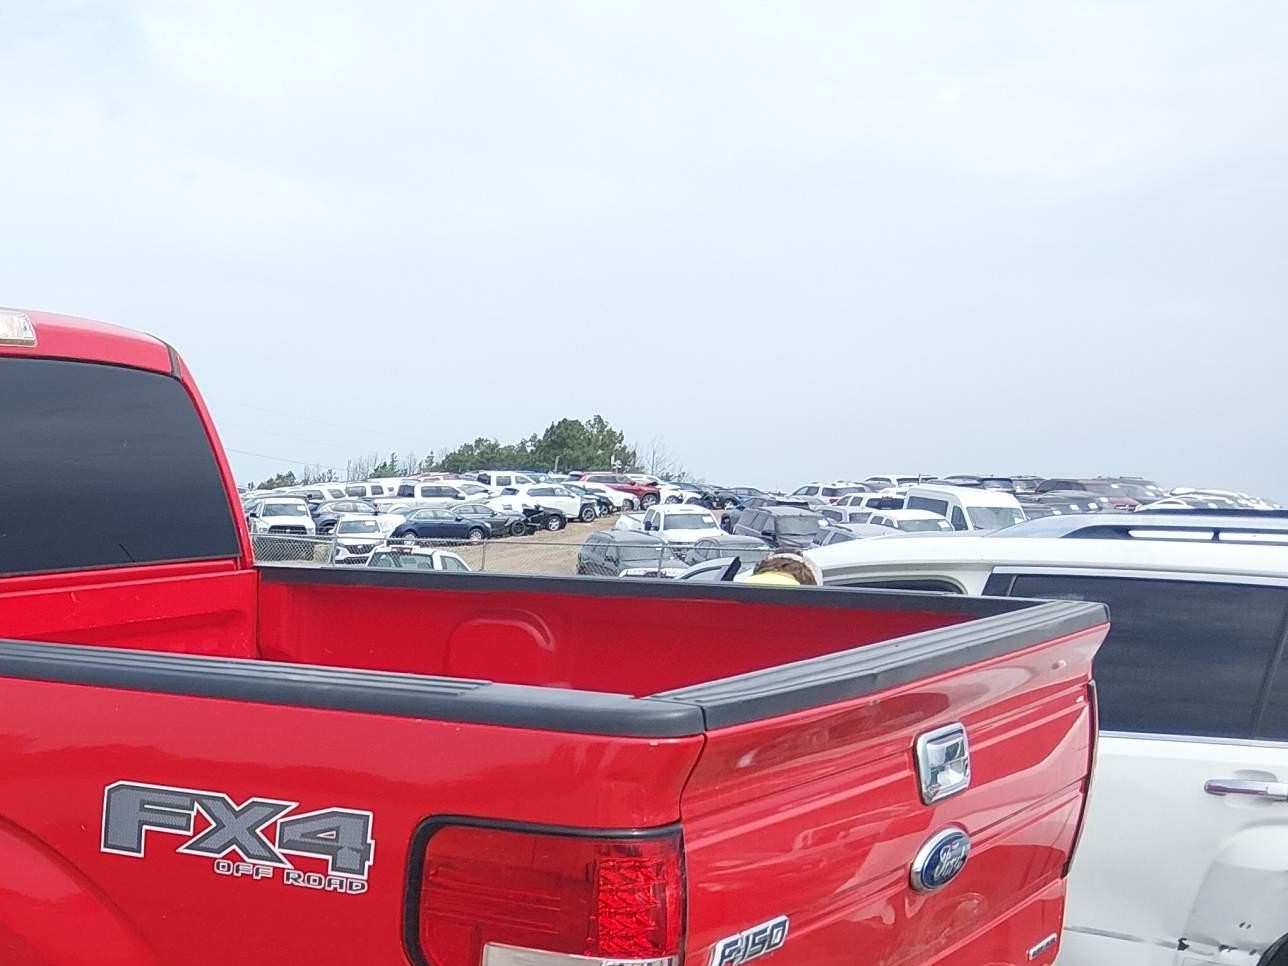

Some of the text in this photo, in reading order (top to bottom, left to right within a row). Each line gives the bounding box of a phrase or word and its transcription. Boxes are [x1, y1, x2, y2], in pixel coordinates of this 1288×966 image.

[100, 779, 375, 879] FX4
[213, 859, 368, 895] OFF ROAD
